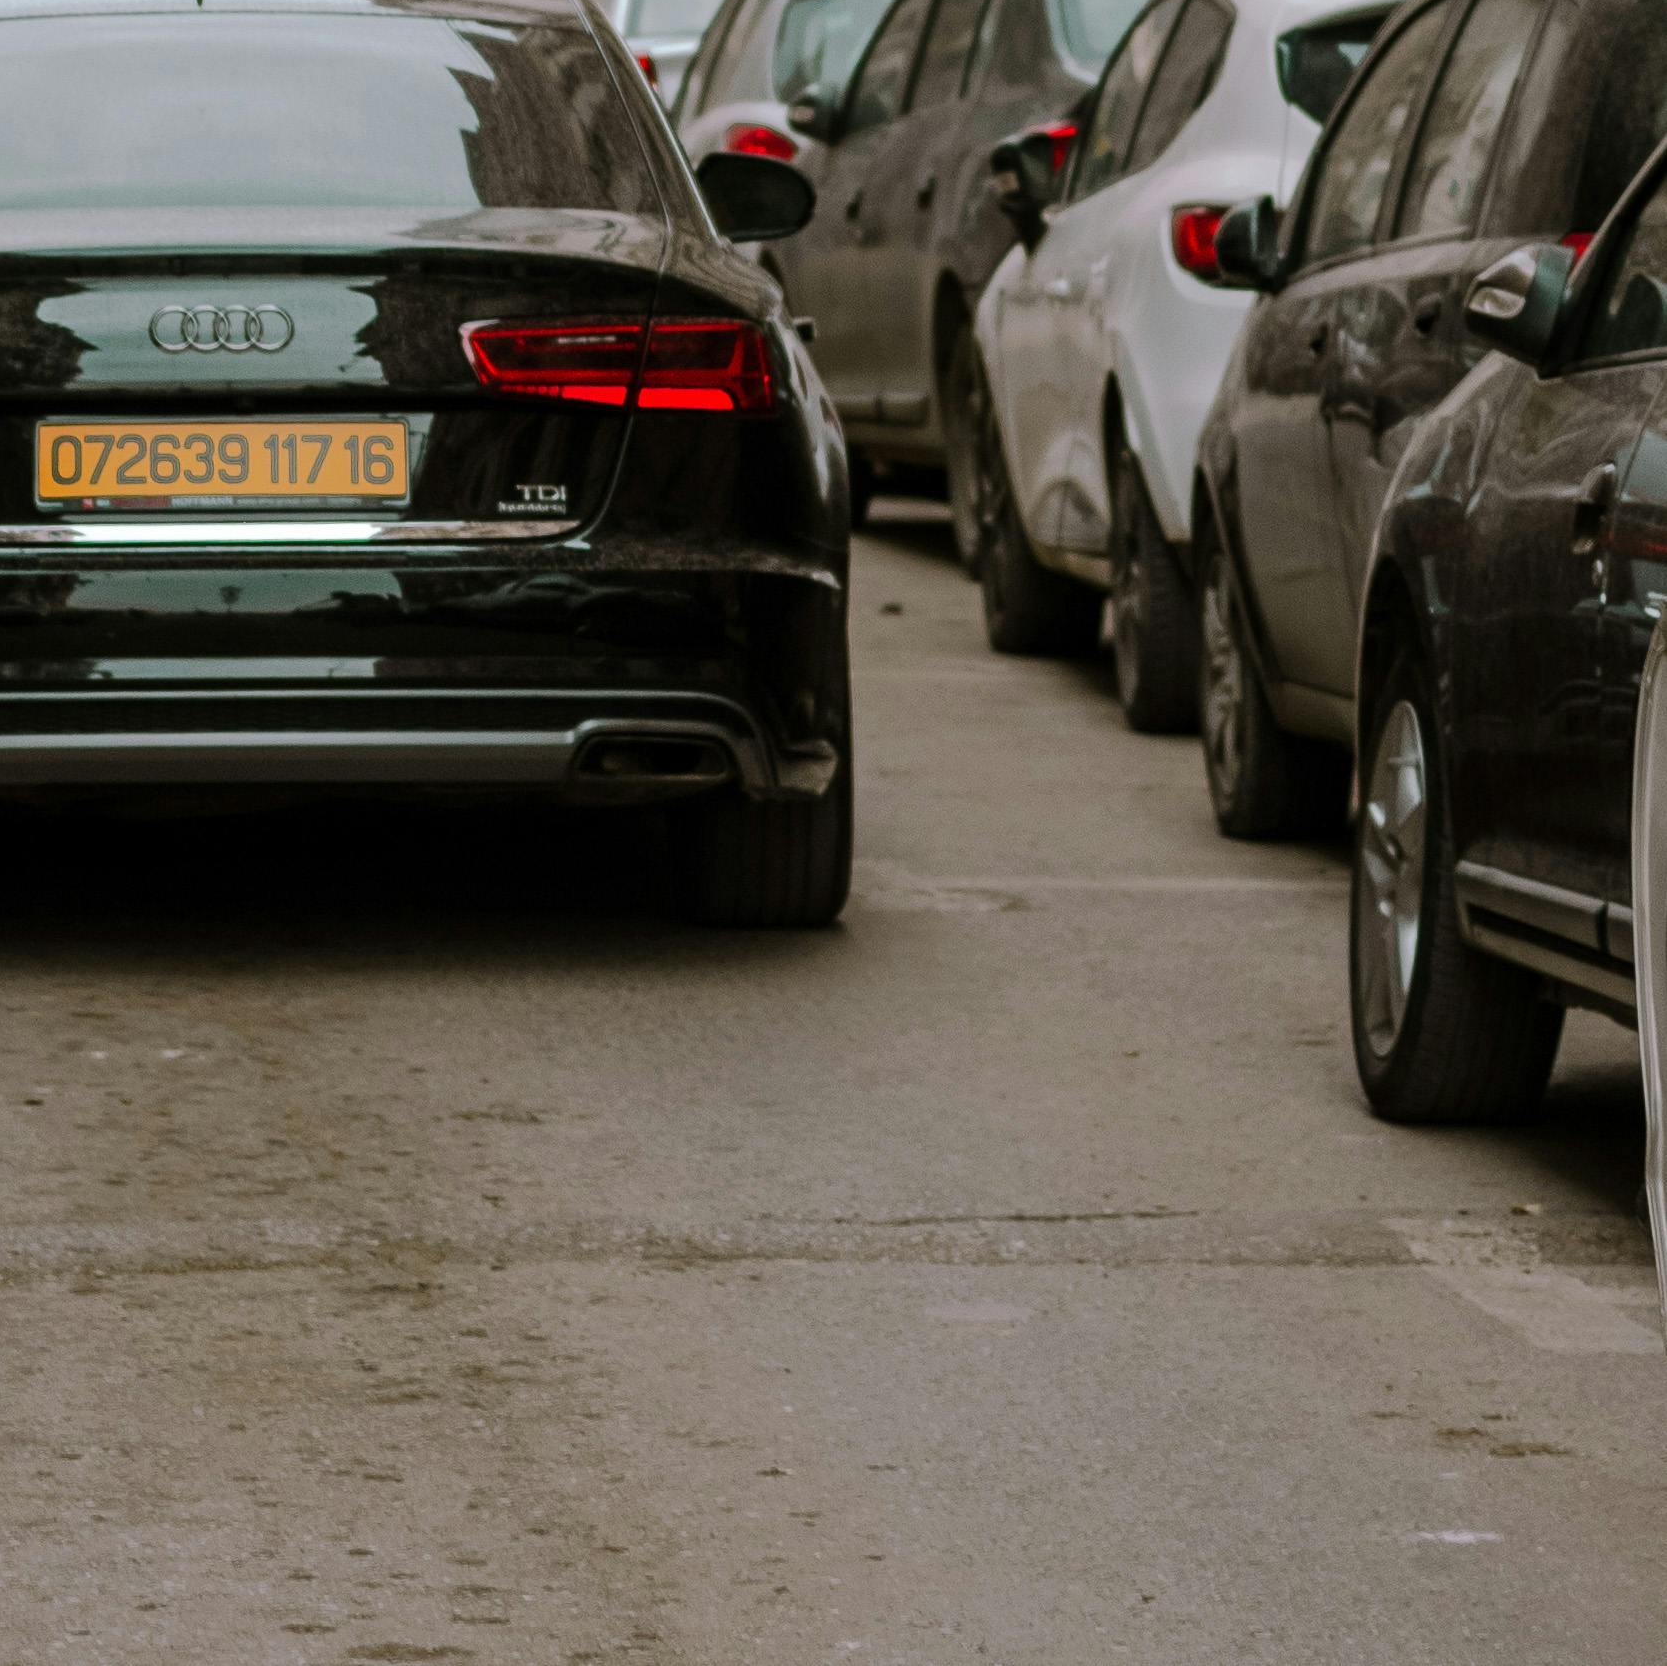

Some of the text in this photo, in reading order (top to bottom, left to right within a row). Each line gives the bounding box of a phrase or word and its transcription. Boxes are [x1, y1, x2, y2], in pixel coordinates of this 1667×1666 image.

[51, 433, 395, 486] 072639 117 16
[516, 484, 566, 501] TDI
